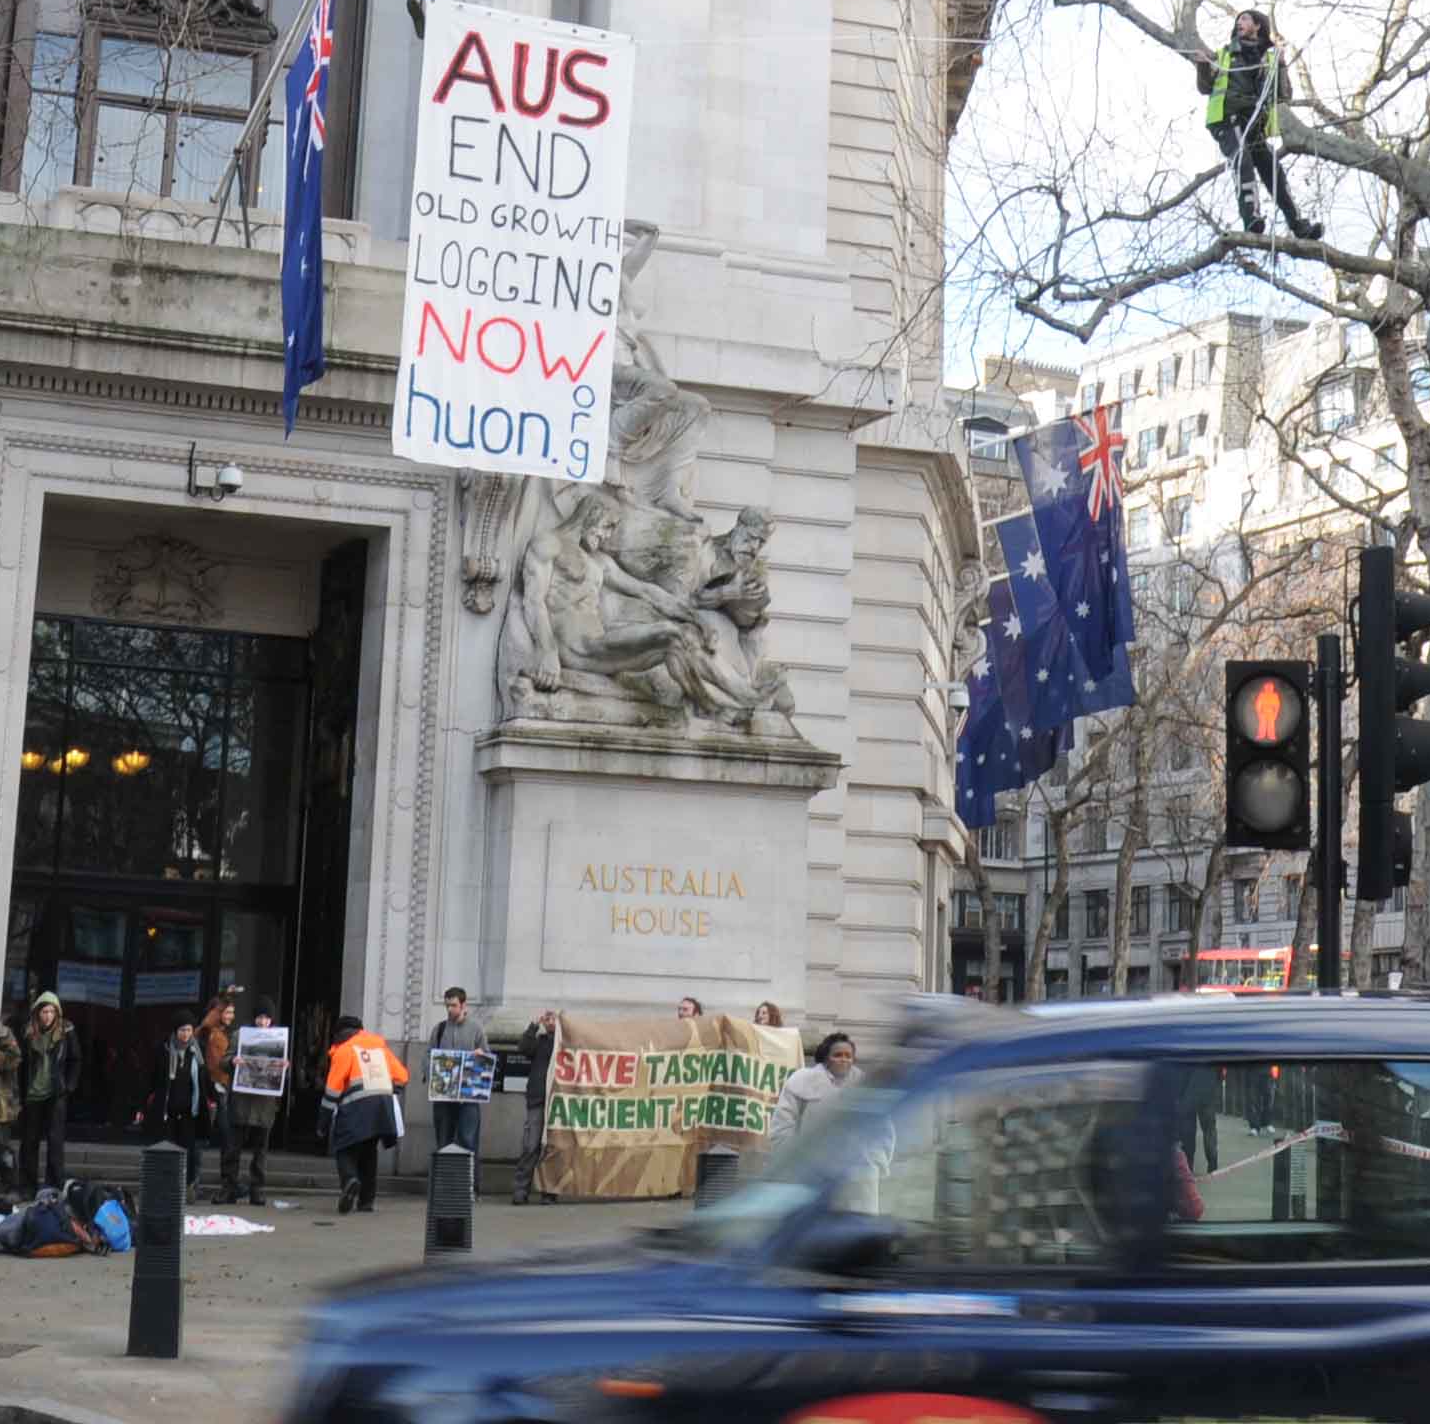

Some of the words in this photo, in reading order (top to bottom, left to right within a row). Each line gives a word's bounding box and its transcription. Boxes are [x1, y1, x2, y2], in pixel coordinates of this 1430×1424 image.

[432, 30, 611, 129] AUS
[449, 114, 592, 199] END
[415, 191, 479, 225] OLD
[490, 203, 623, 253] GROWTH
[413, 234, 614, 316] LOGGING
[417, 301, 606, 383] NOW
[578, 863, 747, 900] AUSTRALIA
[610, 905, 710, 937] HOUSE
[555, 1049, 636, 1085] SAVE
[548, 1095, 676, 1128] ANCIENT
